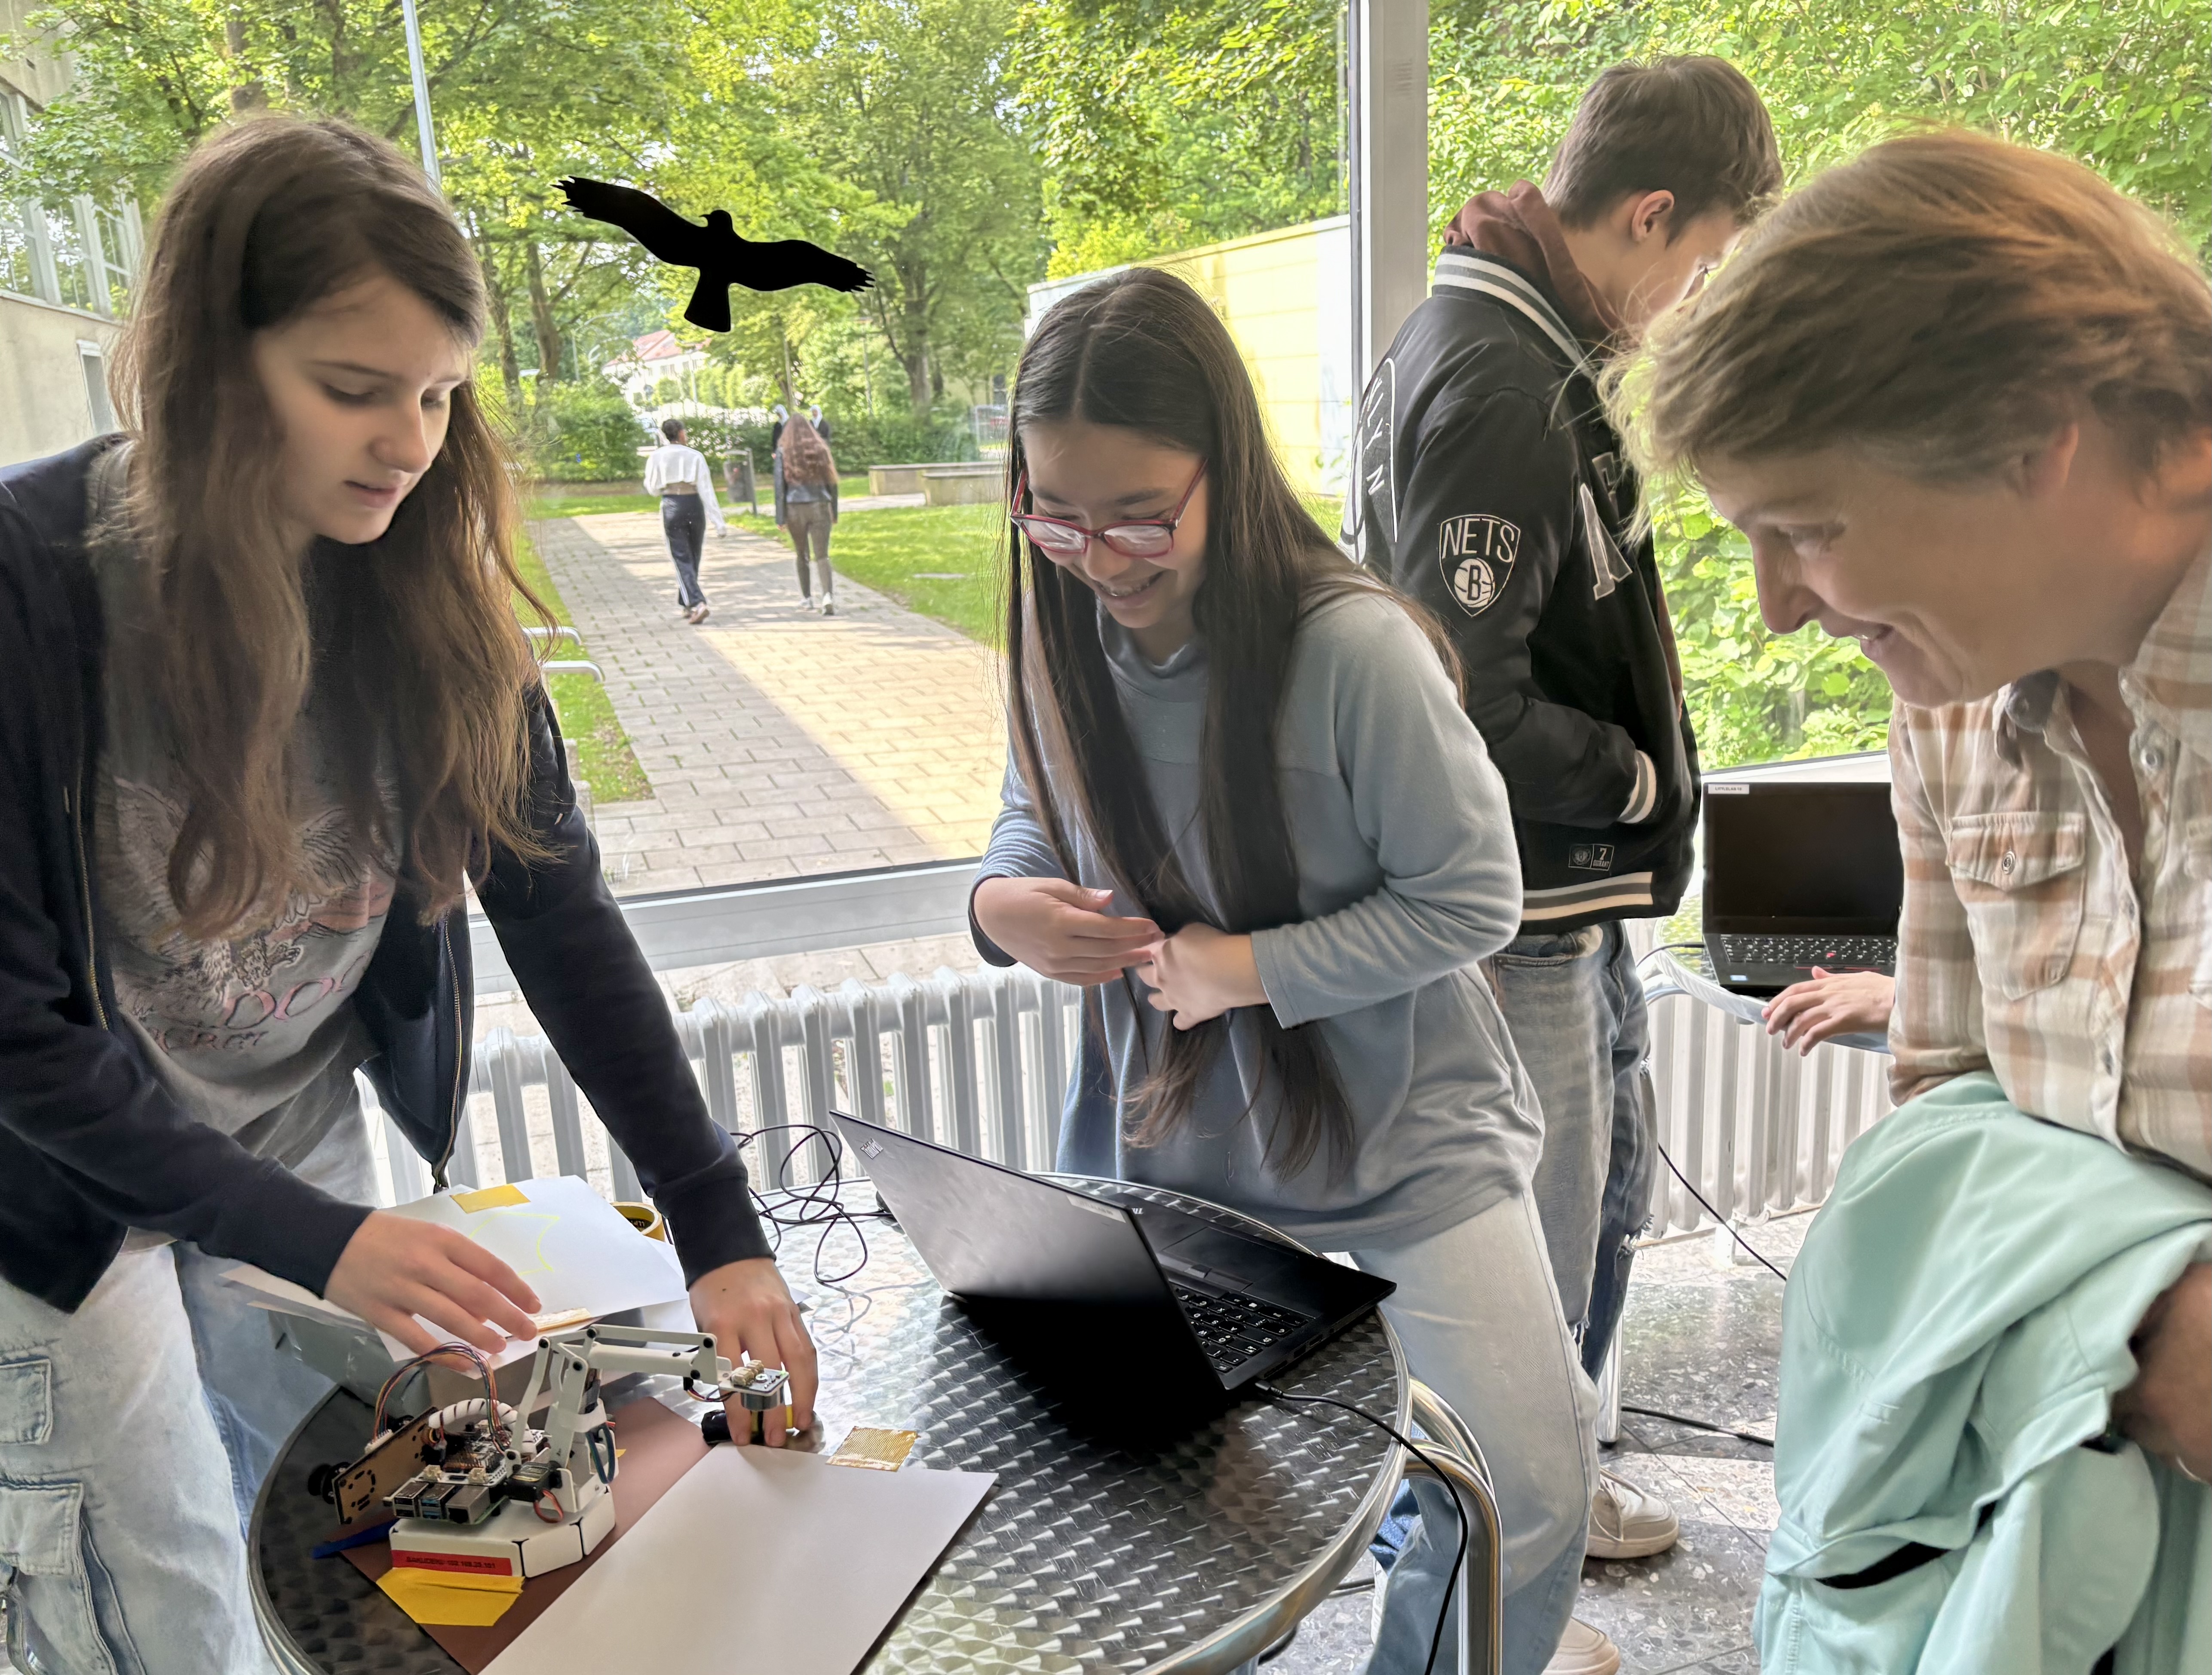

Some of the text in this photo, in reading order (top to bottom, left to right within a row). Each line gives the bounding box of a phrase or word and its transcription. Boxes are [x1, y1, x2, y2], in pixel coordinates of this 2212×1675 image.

[1442, 518, 1514, 563] NETS
[1467, 564, 1482, 601] B
[1599, 847, 1607, 860] 7
